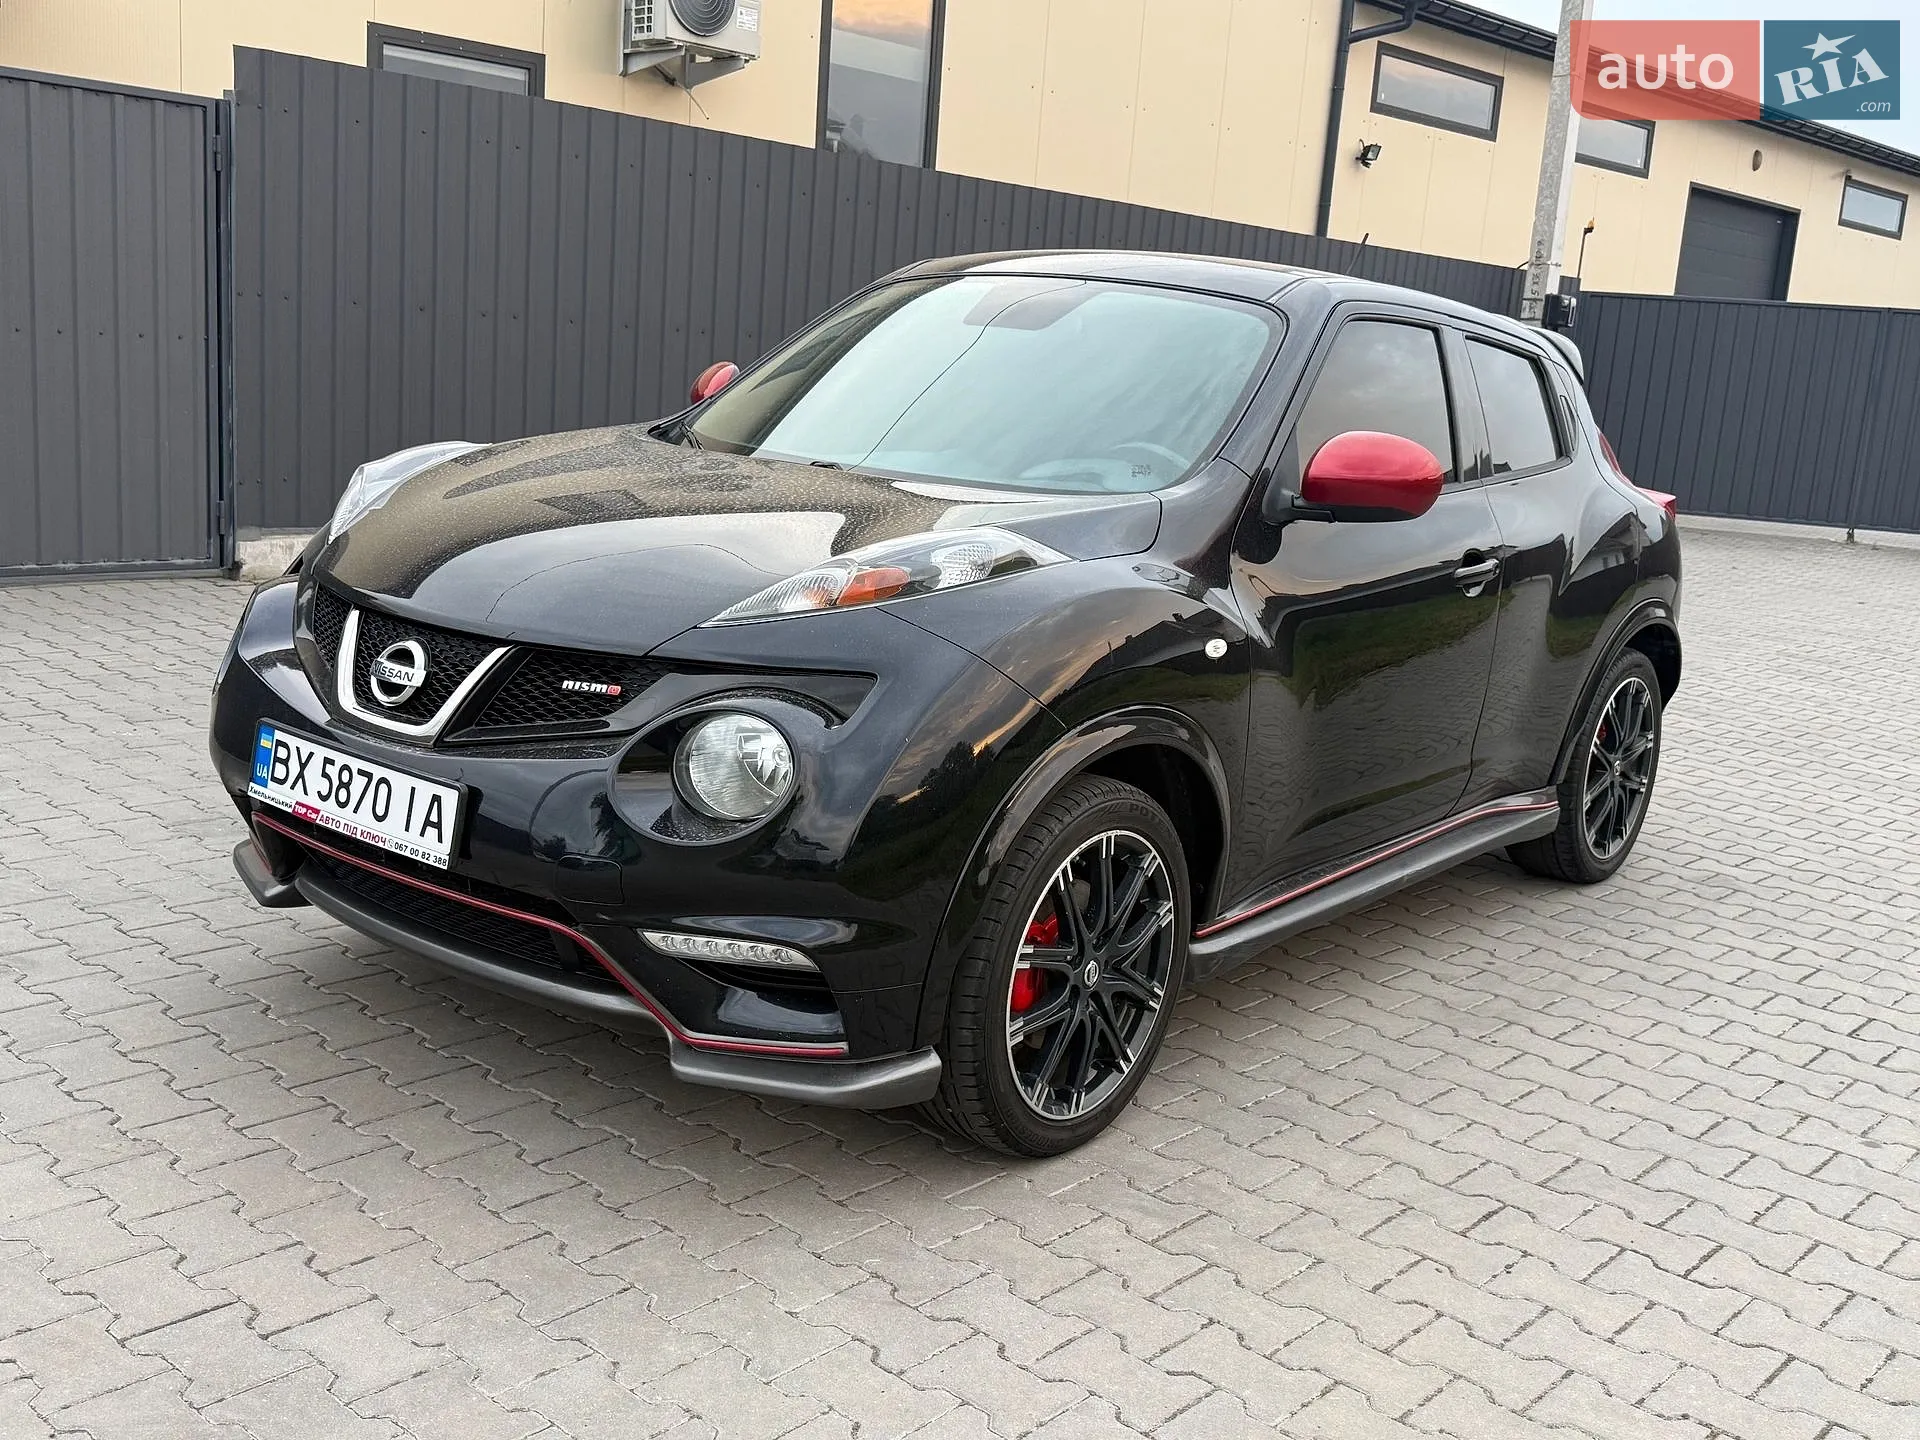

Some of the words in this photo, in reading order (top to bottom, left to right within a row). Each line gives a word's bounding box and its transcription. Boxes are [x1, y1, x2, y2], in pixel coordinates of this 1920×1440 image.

[372, 660, 414, 683] NISSAN
[256, 765, 268, 780] UA
[317, 756, 392, 823] 5870
[294, 804, 307, 815] TOP
[319, 814, 340, 829] АВТО
[343, 823, 358, 837] ПІД
[360, 829, 387, 846] КЛЮЧ
[394, 842, 407, 854] 067
[409, 846, 419, 858] 00
[421, 851, 431, 862] 82
[432, 854, 448, 867] 388
